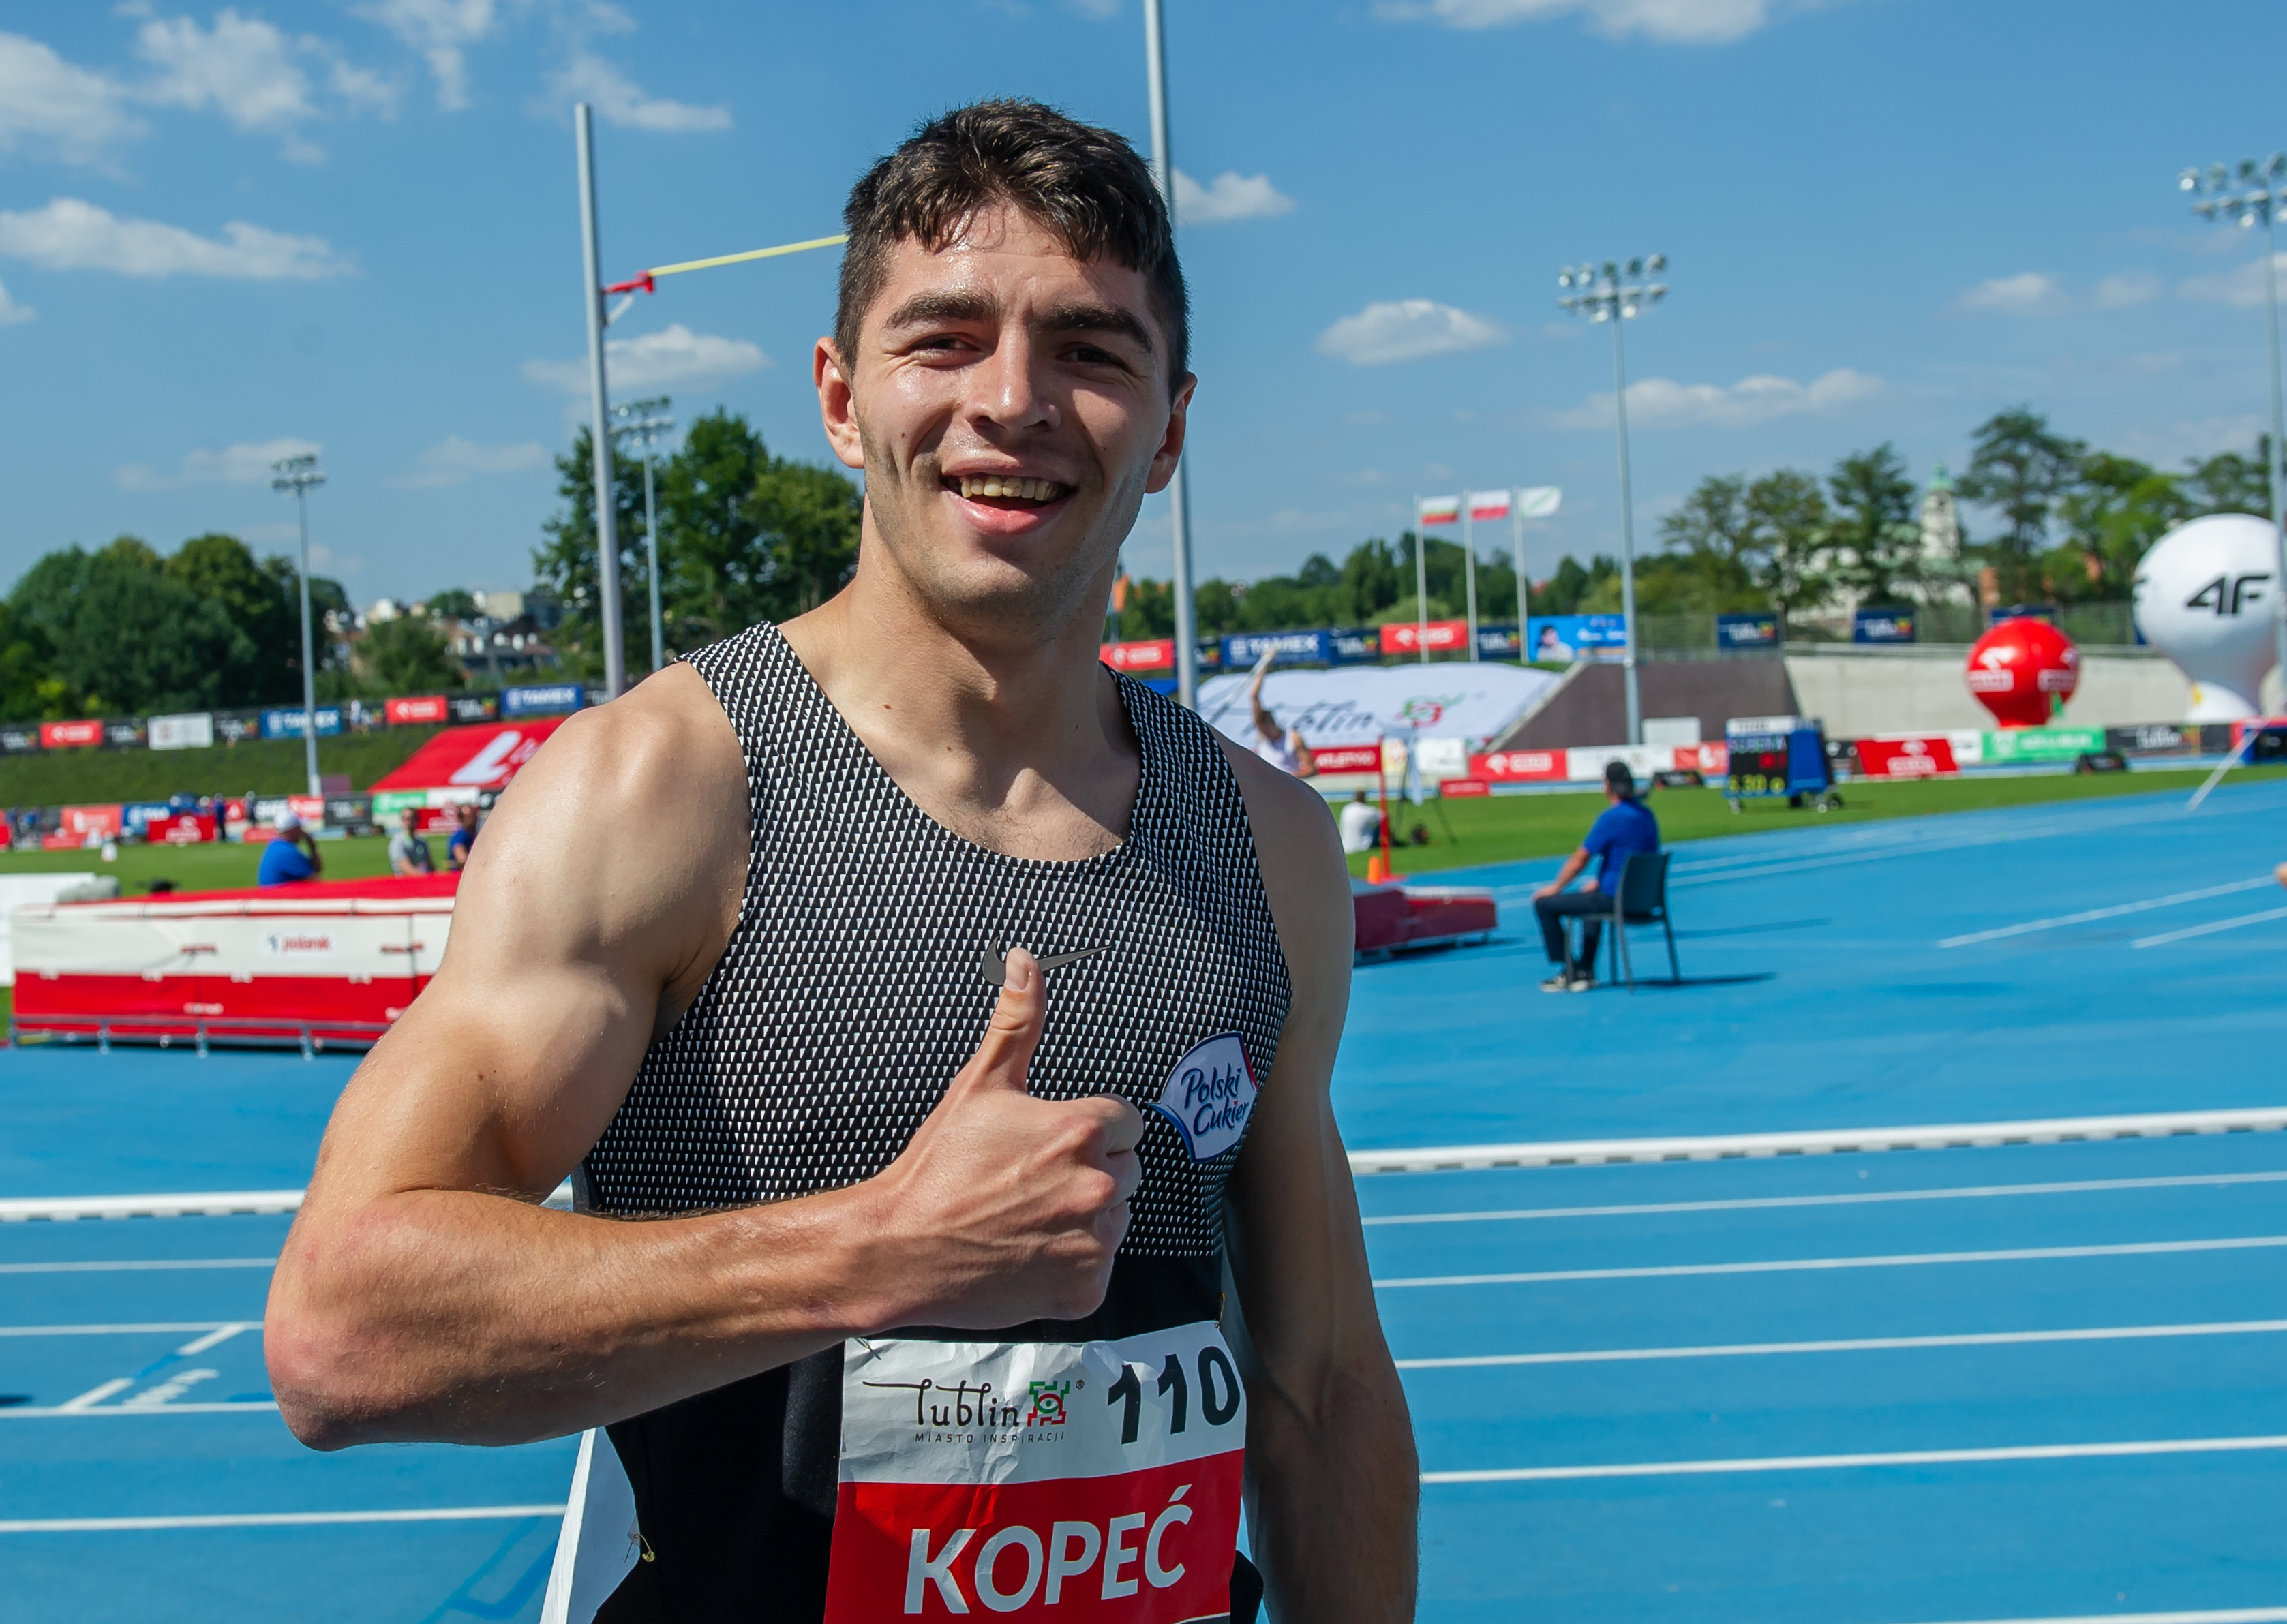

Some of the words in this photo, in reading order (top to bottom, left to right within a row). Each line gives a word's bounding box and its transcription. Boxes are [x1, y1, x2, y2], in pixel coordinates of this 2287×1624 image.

[2187, 574, 2270, 615] 4F
[1181, 1062, 1243, 1109] Polski
[1193, 1096, 1249, 1137] Cukier
[1106, 1345, 1241, 1445] 110
[914, 1433, 973, 1444] MIASTO
[983, 1431, 1065, 1443] INSPIRACJI
[903, 1483, 1194, 1615] KOPEĆ
